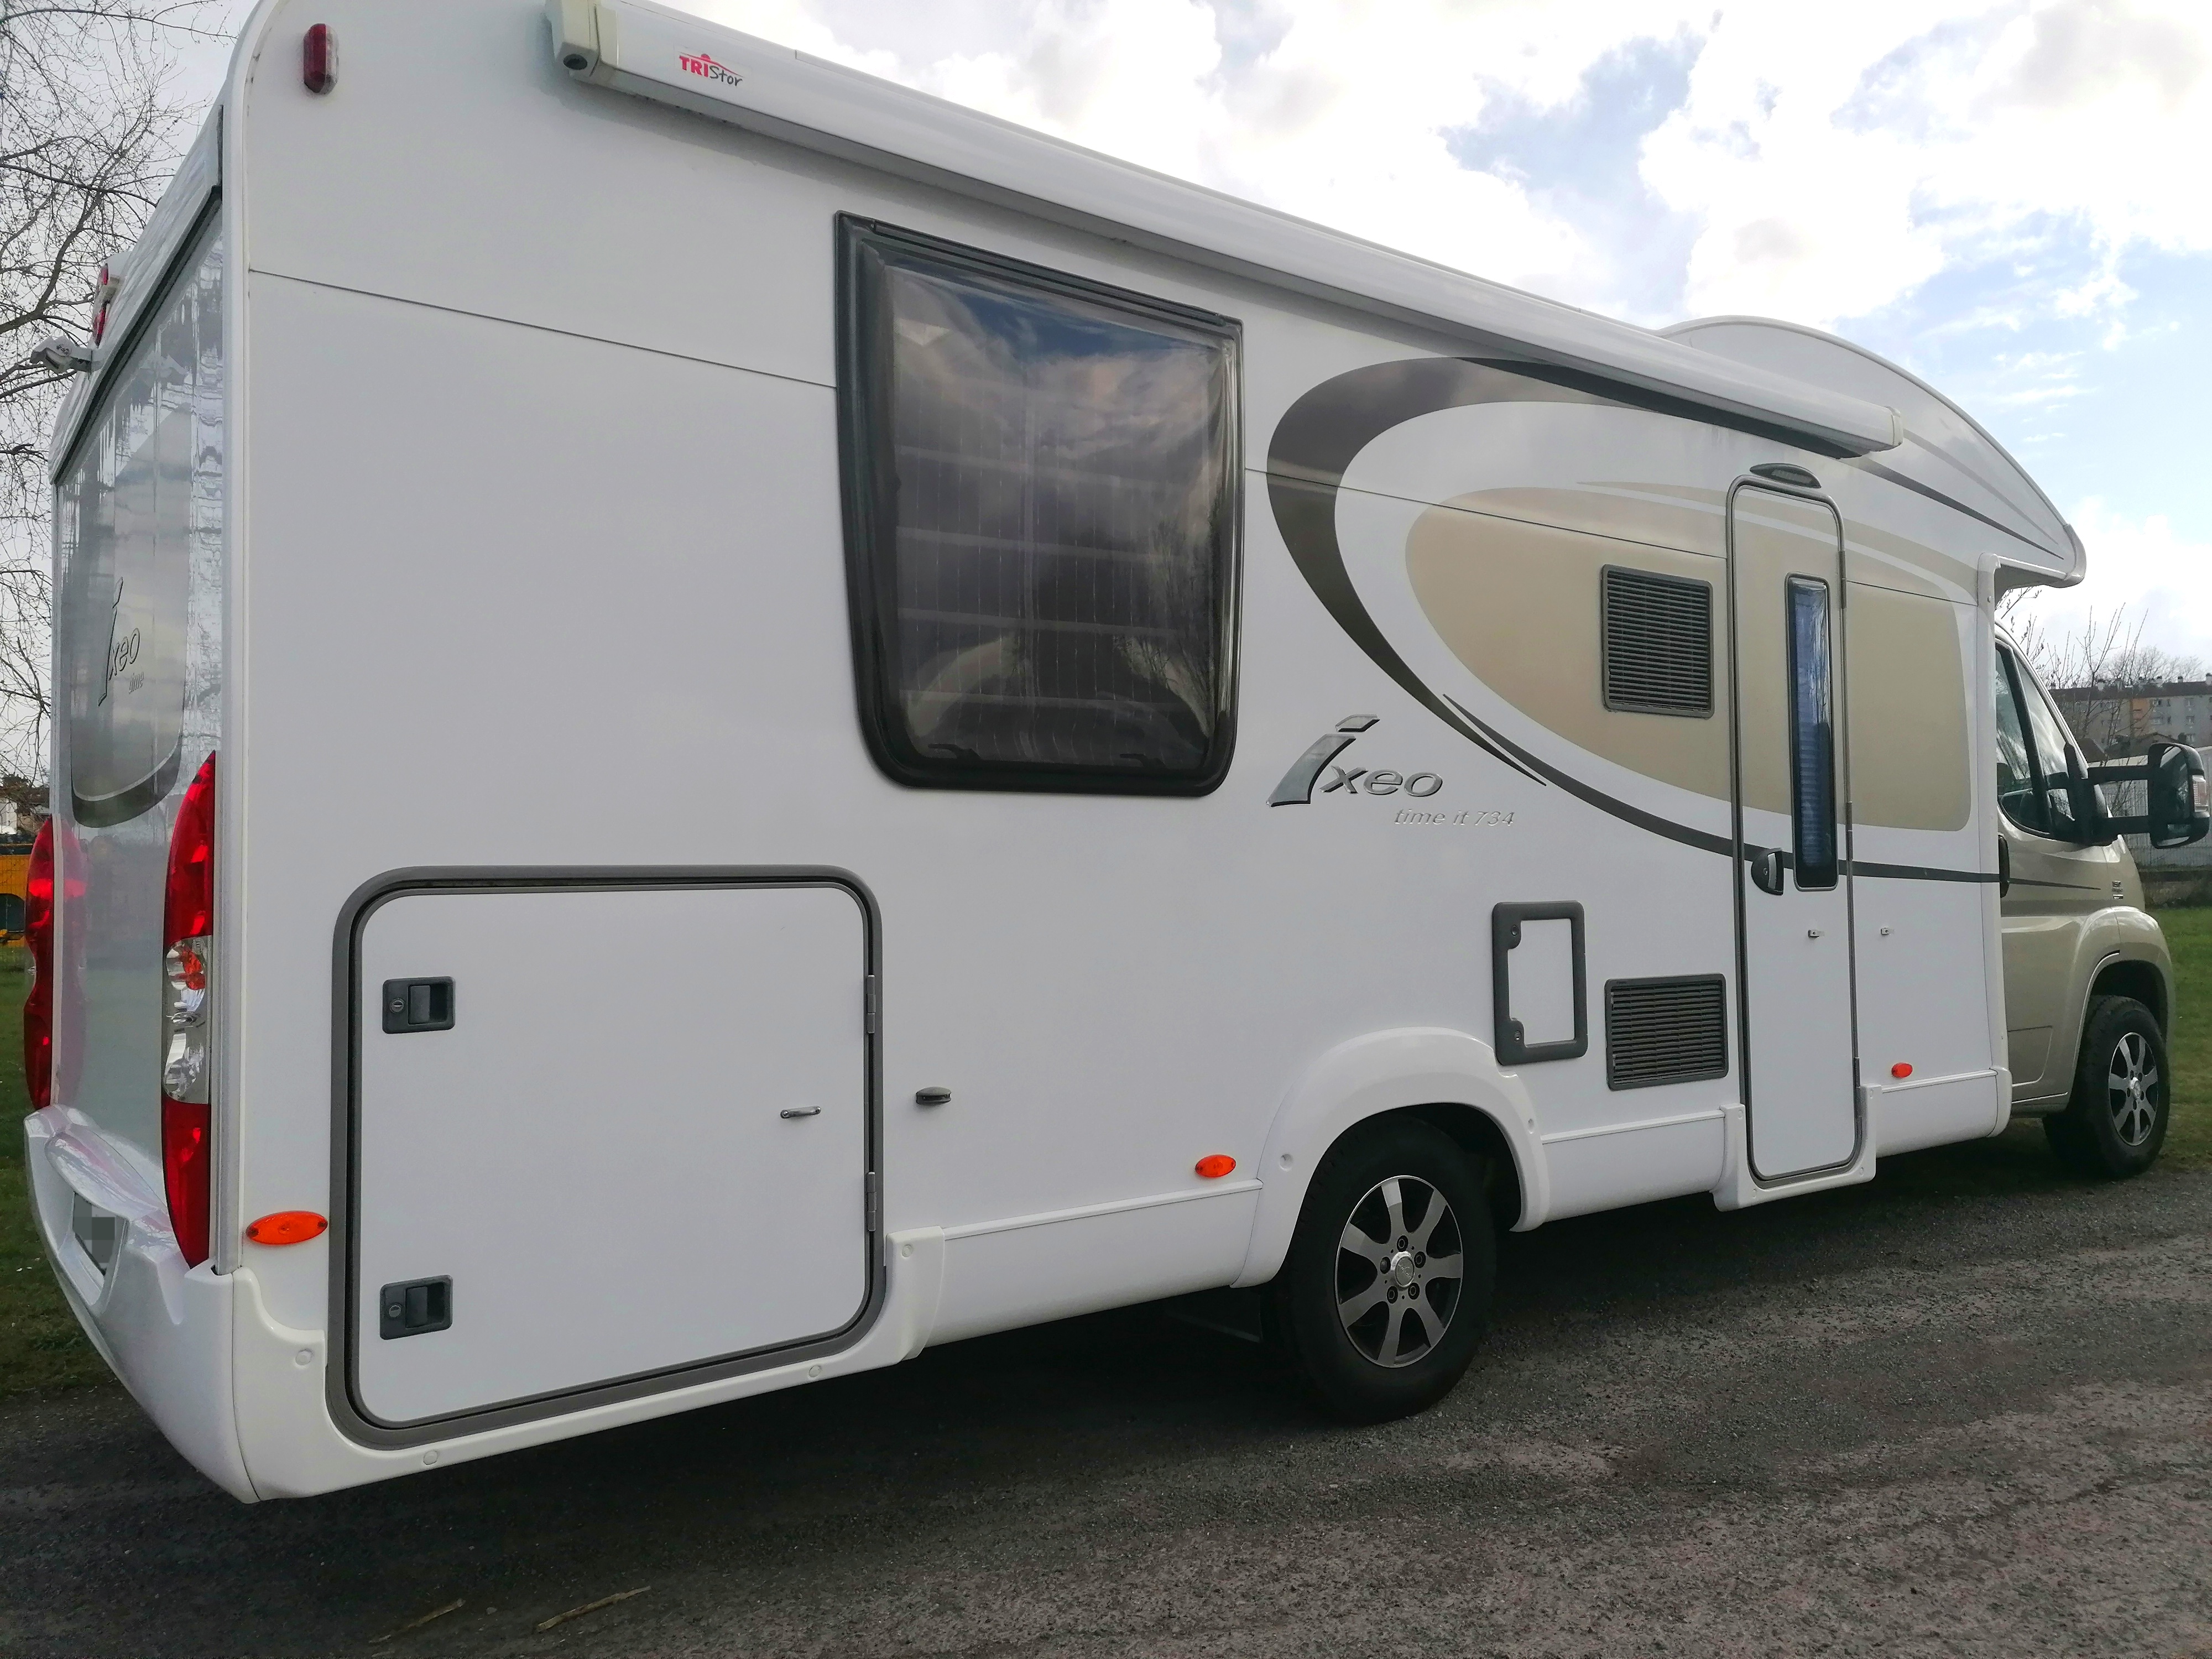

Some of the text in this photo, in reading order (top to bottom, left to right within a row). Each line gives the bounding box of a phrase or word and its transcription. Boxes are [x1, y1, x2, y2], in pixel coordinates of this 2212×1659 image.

[1394, 808, 1514, 826] time it 734
